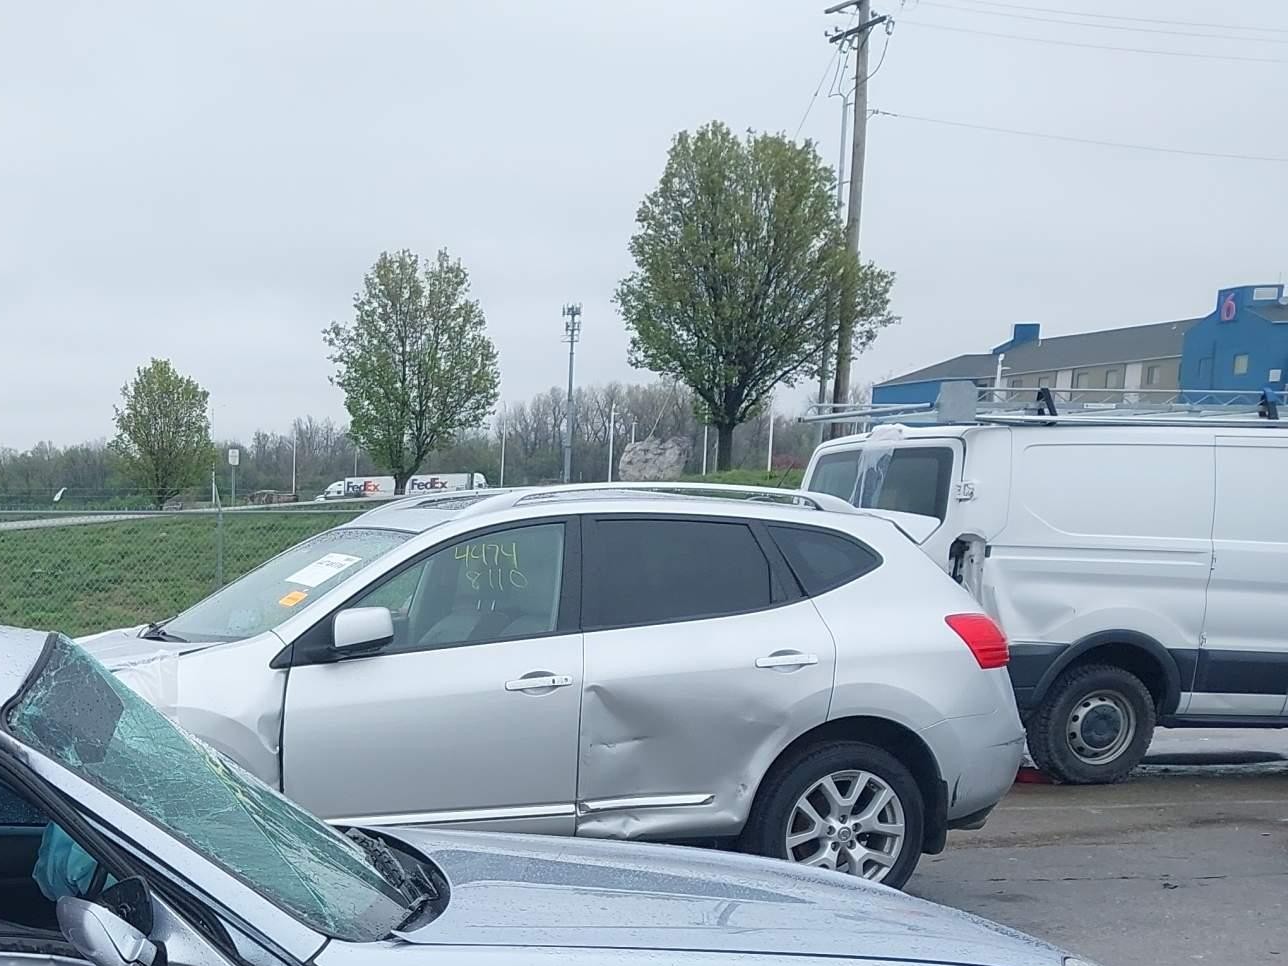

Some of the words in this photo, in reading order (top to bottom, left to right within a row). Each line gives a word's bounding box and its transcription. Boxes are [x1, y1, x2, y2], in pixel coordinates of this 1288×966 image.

[1221, 292, 1237, 321] 6
[347, 480, 380, 493] FedEx
[411, 477, 448, 490] FedEx
[454, 542, 518, 570] 4474
[466, 565, 528, 592] 8110
